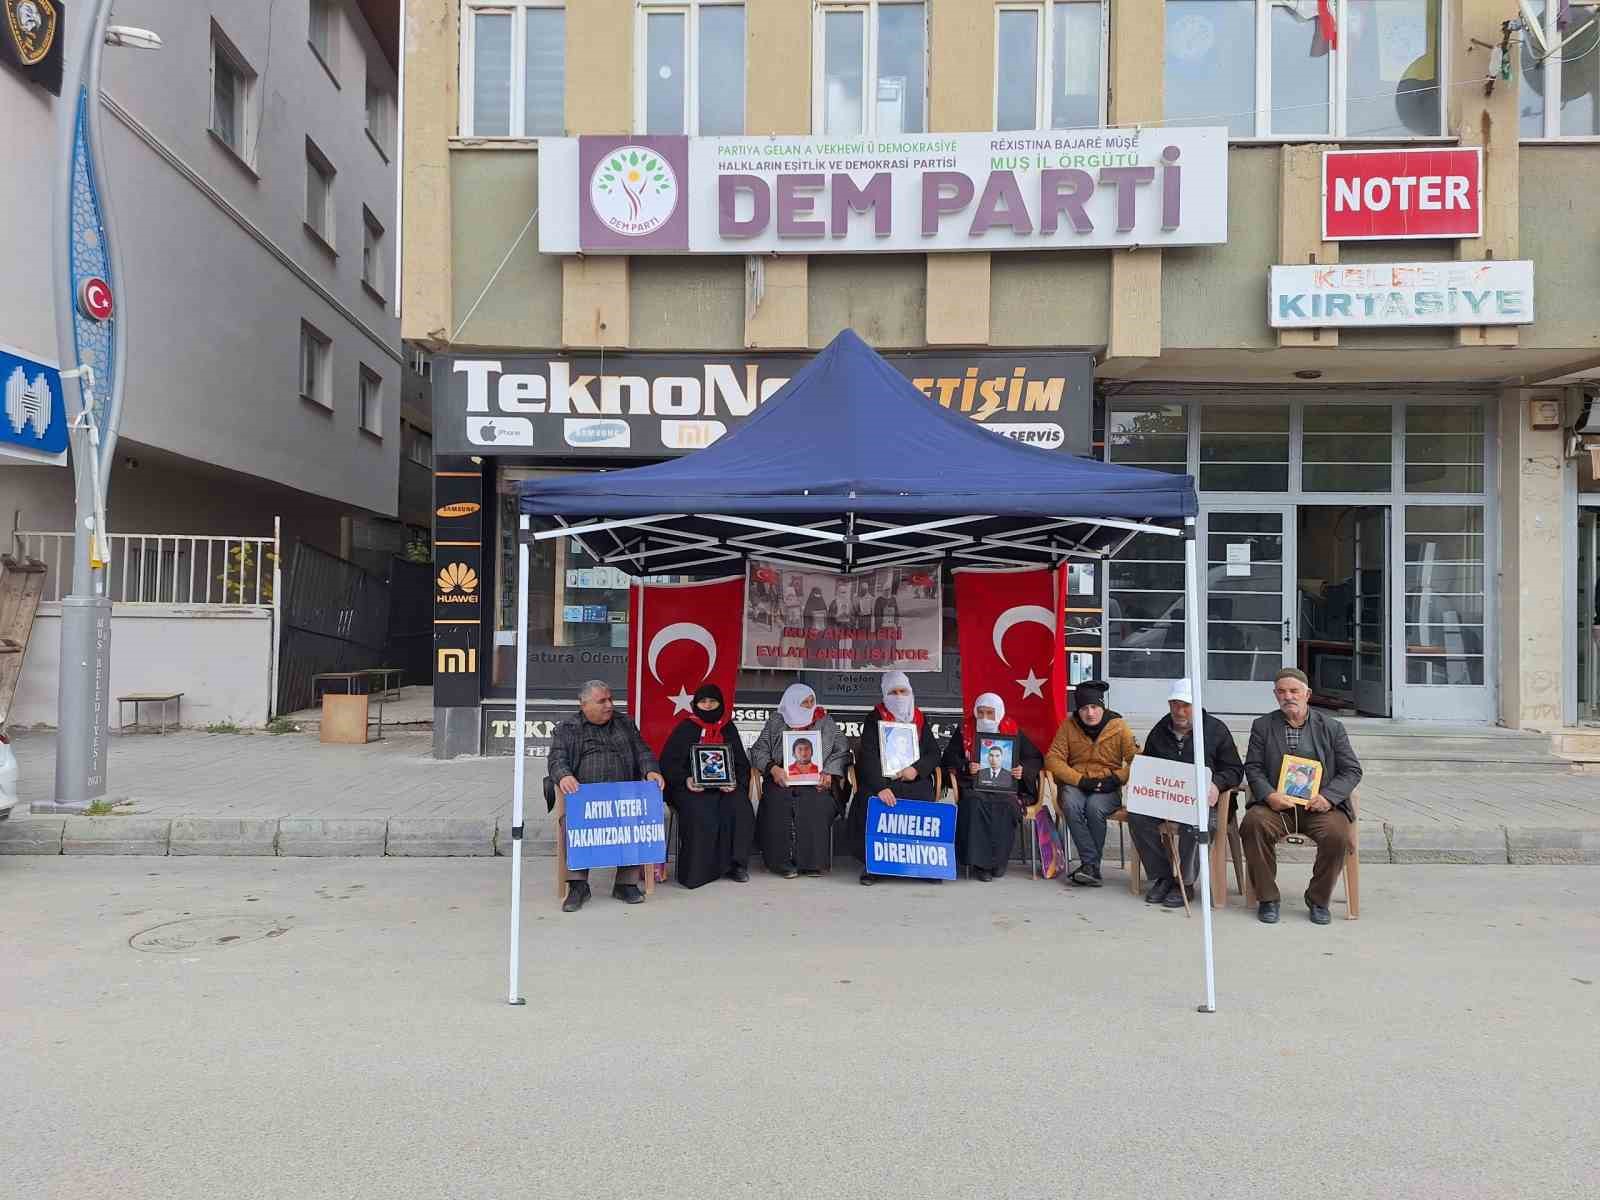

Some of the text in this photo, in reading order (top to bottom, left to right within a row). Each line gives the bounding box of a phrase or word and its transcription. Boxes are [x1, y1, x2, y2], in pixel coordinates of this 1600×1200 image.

[766, 144, 801, 156] GELAN
[718, 156, 957, 172] HALKLARIN EŞİTLİK VE DEMOKRASİ PARTİSİ
[990, 151, 1139, 172] MUŞ İL ÖRGÜTÜ
[718, 144, 1182, 238] DEM PARTİ
[1334, 175, 1471, 212] NOTER
[609, 216, 629, 231] DEM
[1279, 287, 1523, 319] KIRTASİYE
[437, 595, 478, 603] HUAWEI
[529, 651, 574, 664] atura
[1155, 775, 1186, 790] EVLAT
[584, 800, 613, 819] ARTIK
[615, 799, 642, 818] YETER
[568, 819, 665, 848] YAKAMIZDAN DÜŞÜN
[877, 812, 941, 838] ANNELER
[873, 837, 948, 867] DİRENİYOR
